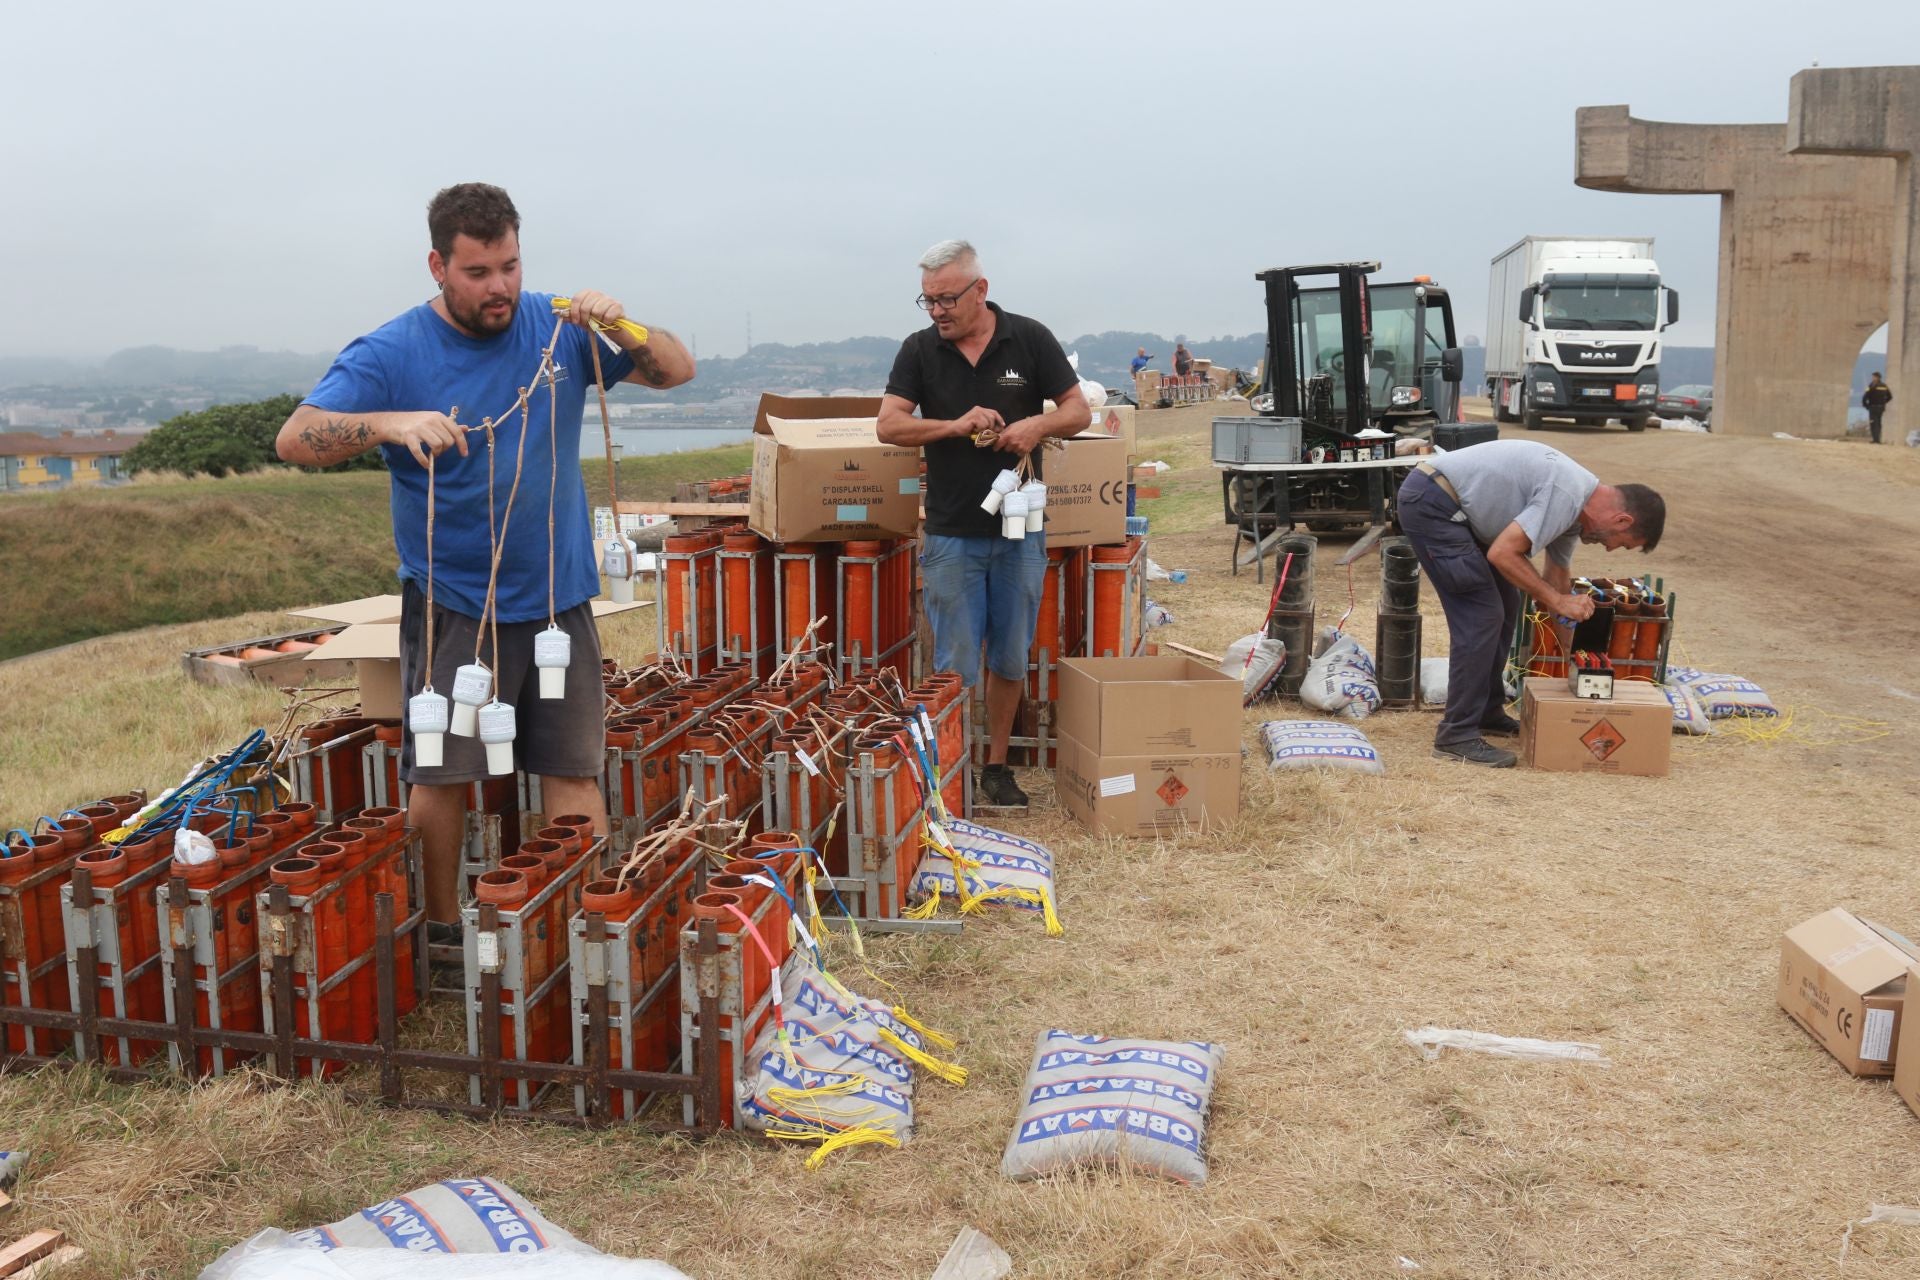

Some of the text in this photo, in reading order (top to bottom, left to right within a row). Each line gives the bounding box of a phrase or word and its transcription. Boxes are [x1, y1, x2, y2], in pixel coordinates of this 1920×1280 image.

[1580, 352, 1617, 360] MAN
[831, 486, 860, 494] DISPLAY
[862, 485, 884, 493] SHELL
[1100, 481, 1123, 505] CE
[822, 498, 857, 506] CARCASA
[1204, 757, 1231, 769] 378
[1278, 747, 1373, 758] OBRAMAT
[1837, 1007, 1852, 1039] CE
[1043, 1050, 1204, 1075] OBRAMAT
[1033, 1078, 1199, 1106] OBRAMAT
[1023, 1109, 1195, 1142] OBRAMAT
[452, 1179, 538, 1253] OBRAM
